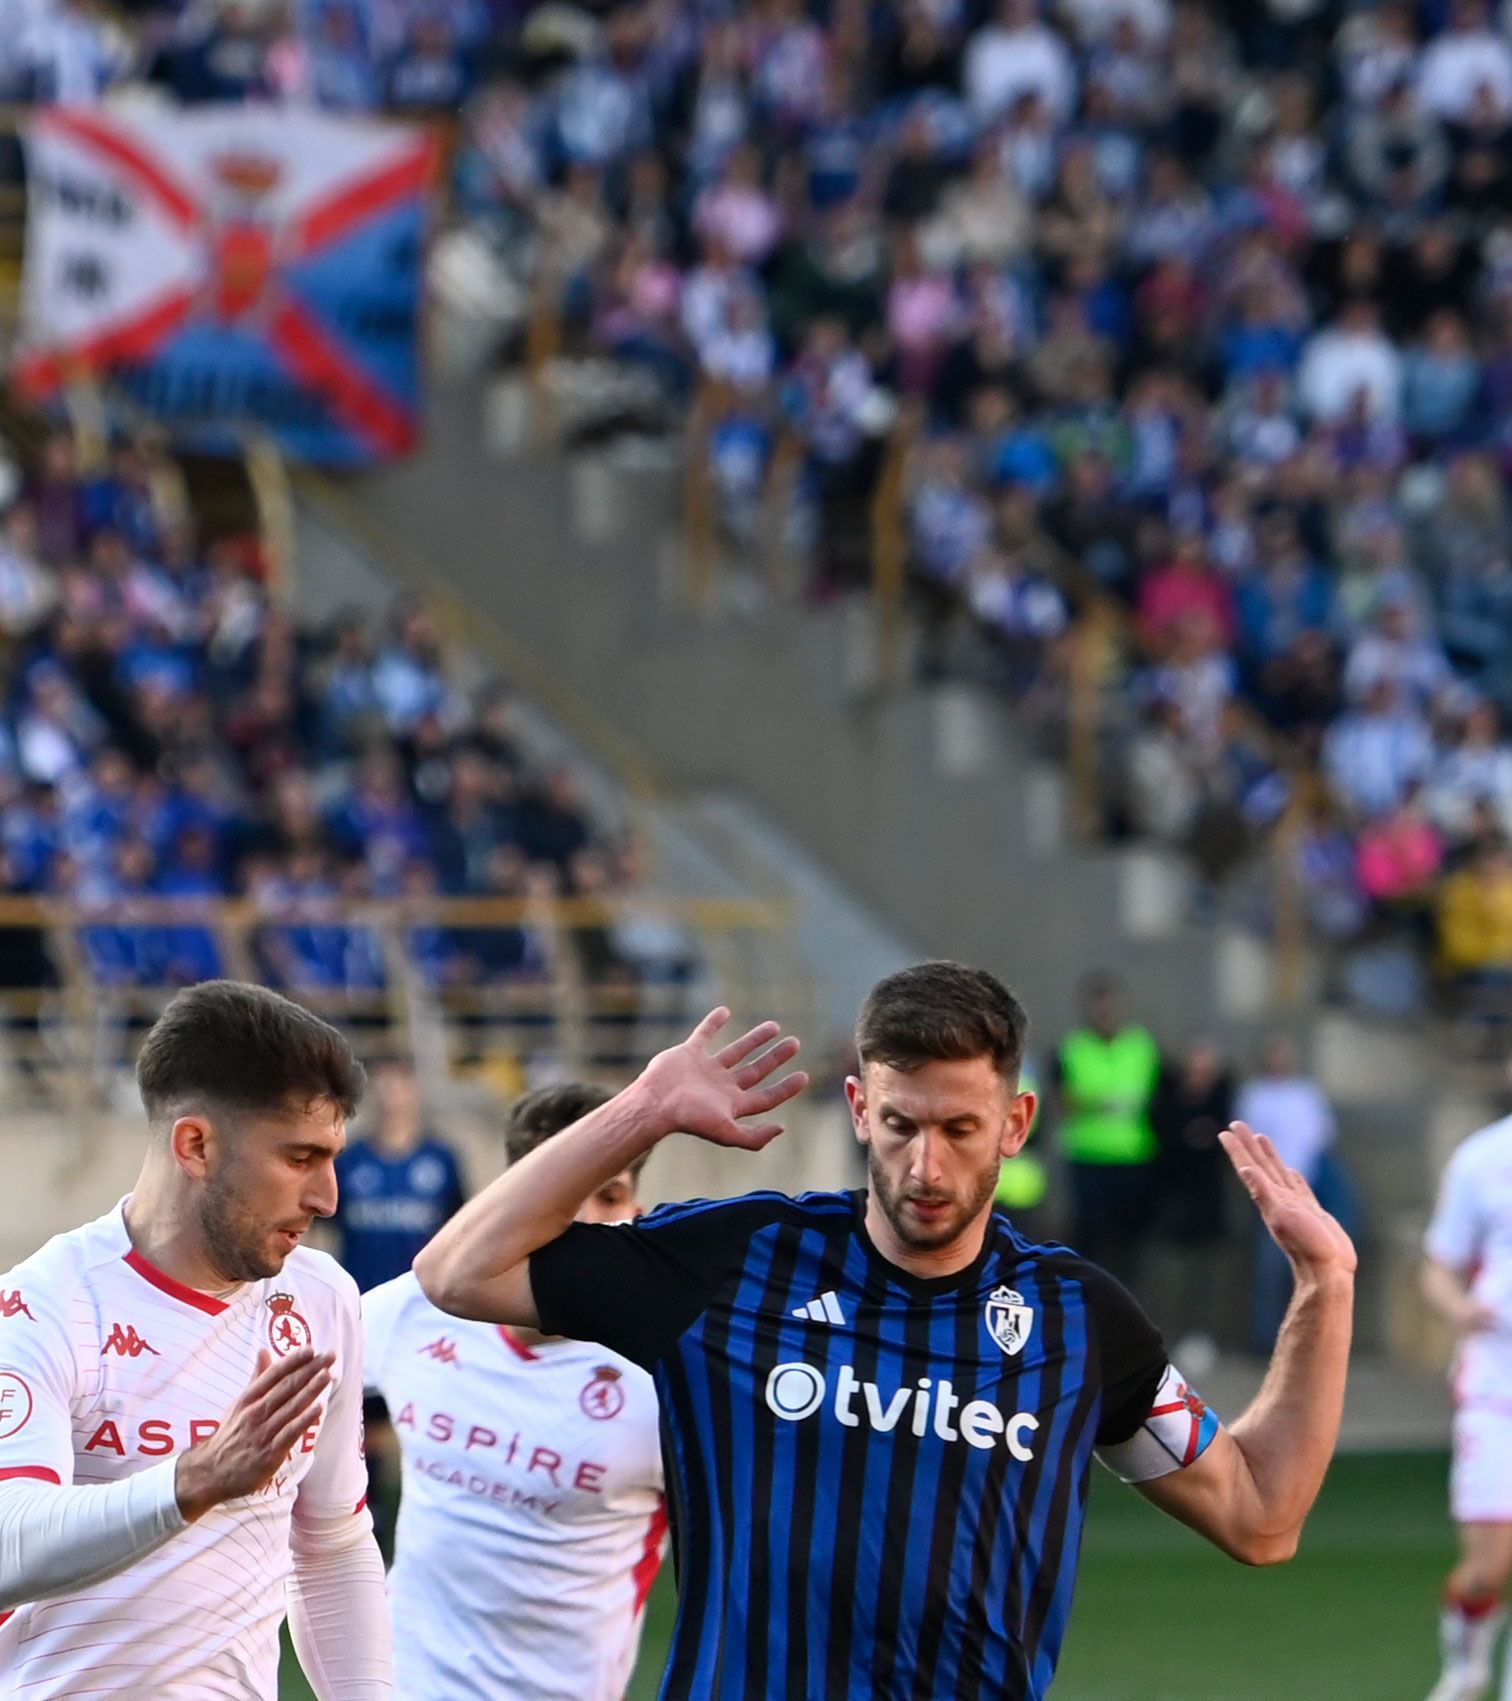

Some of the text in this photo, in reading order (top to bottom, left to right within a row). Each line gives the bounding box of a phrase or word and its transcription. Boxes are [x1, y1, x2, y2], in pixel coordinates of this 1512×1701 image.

[84, 1414, 321, 1455] ASPE
[396, 1401, 608, 1495] ASPIRE
[834, 1364, 1040, 1462] tvitec
[414, 1457, 562, 1515] ACADEMY
